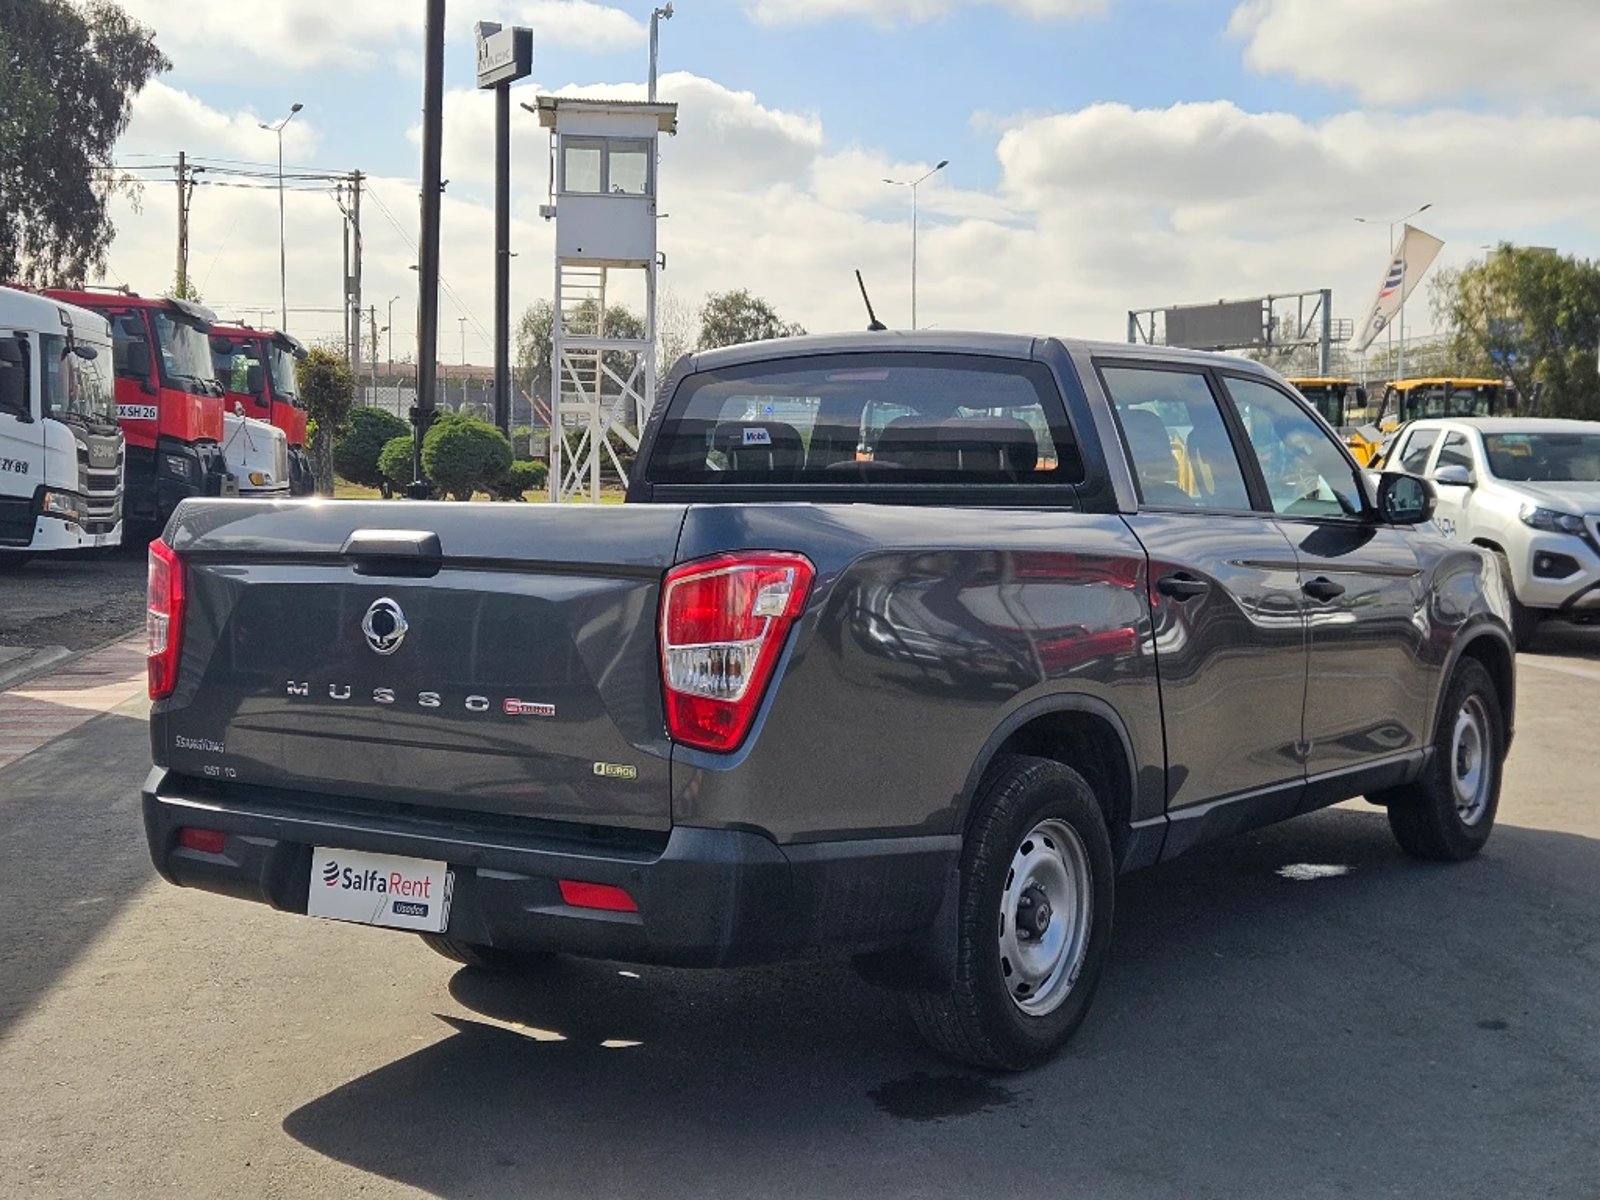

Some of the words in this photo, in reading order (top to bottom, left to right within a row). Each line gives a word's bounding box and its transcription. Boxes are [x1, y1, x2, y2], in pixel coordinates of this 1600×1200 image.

[127, 405, 142, 418] SH
[143, 406, 156, 418] 26
[286, 680, 490, 711] MUSSO
[341, 866, 432, 899] SalfaRent
